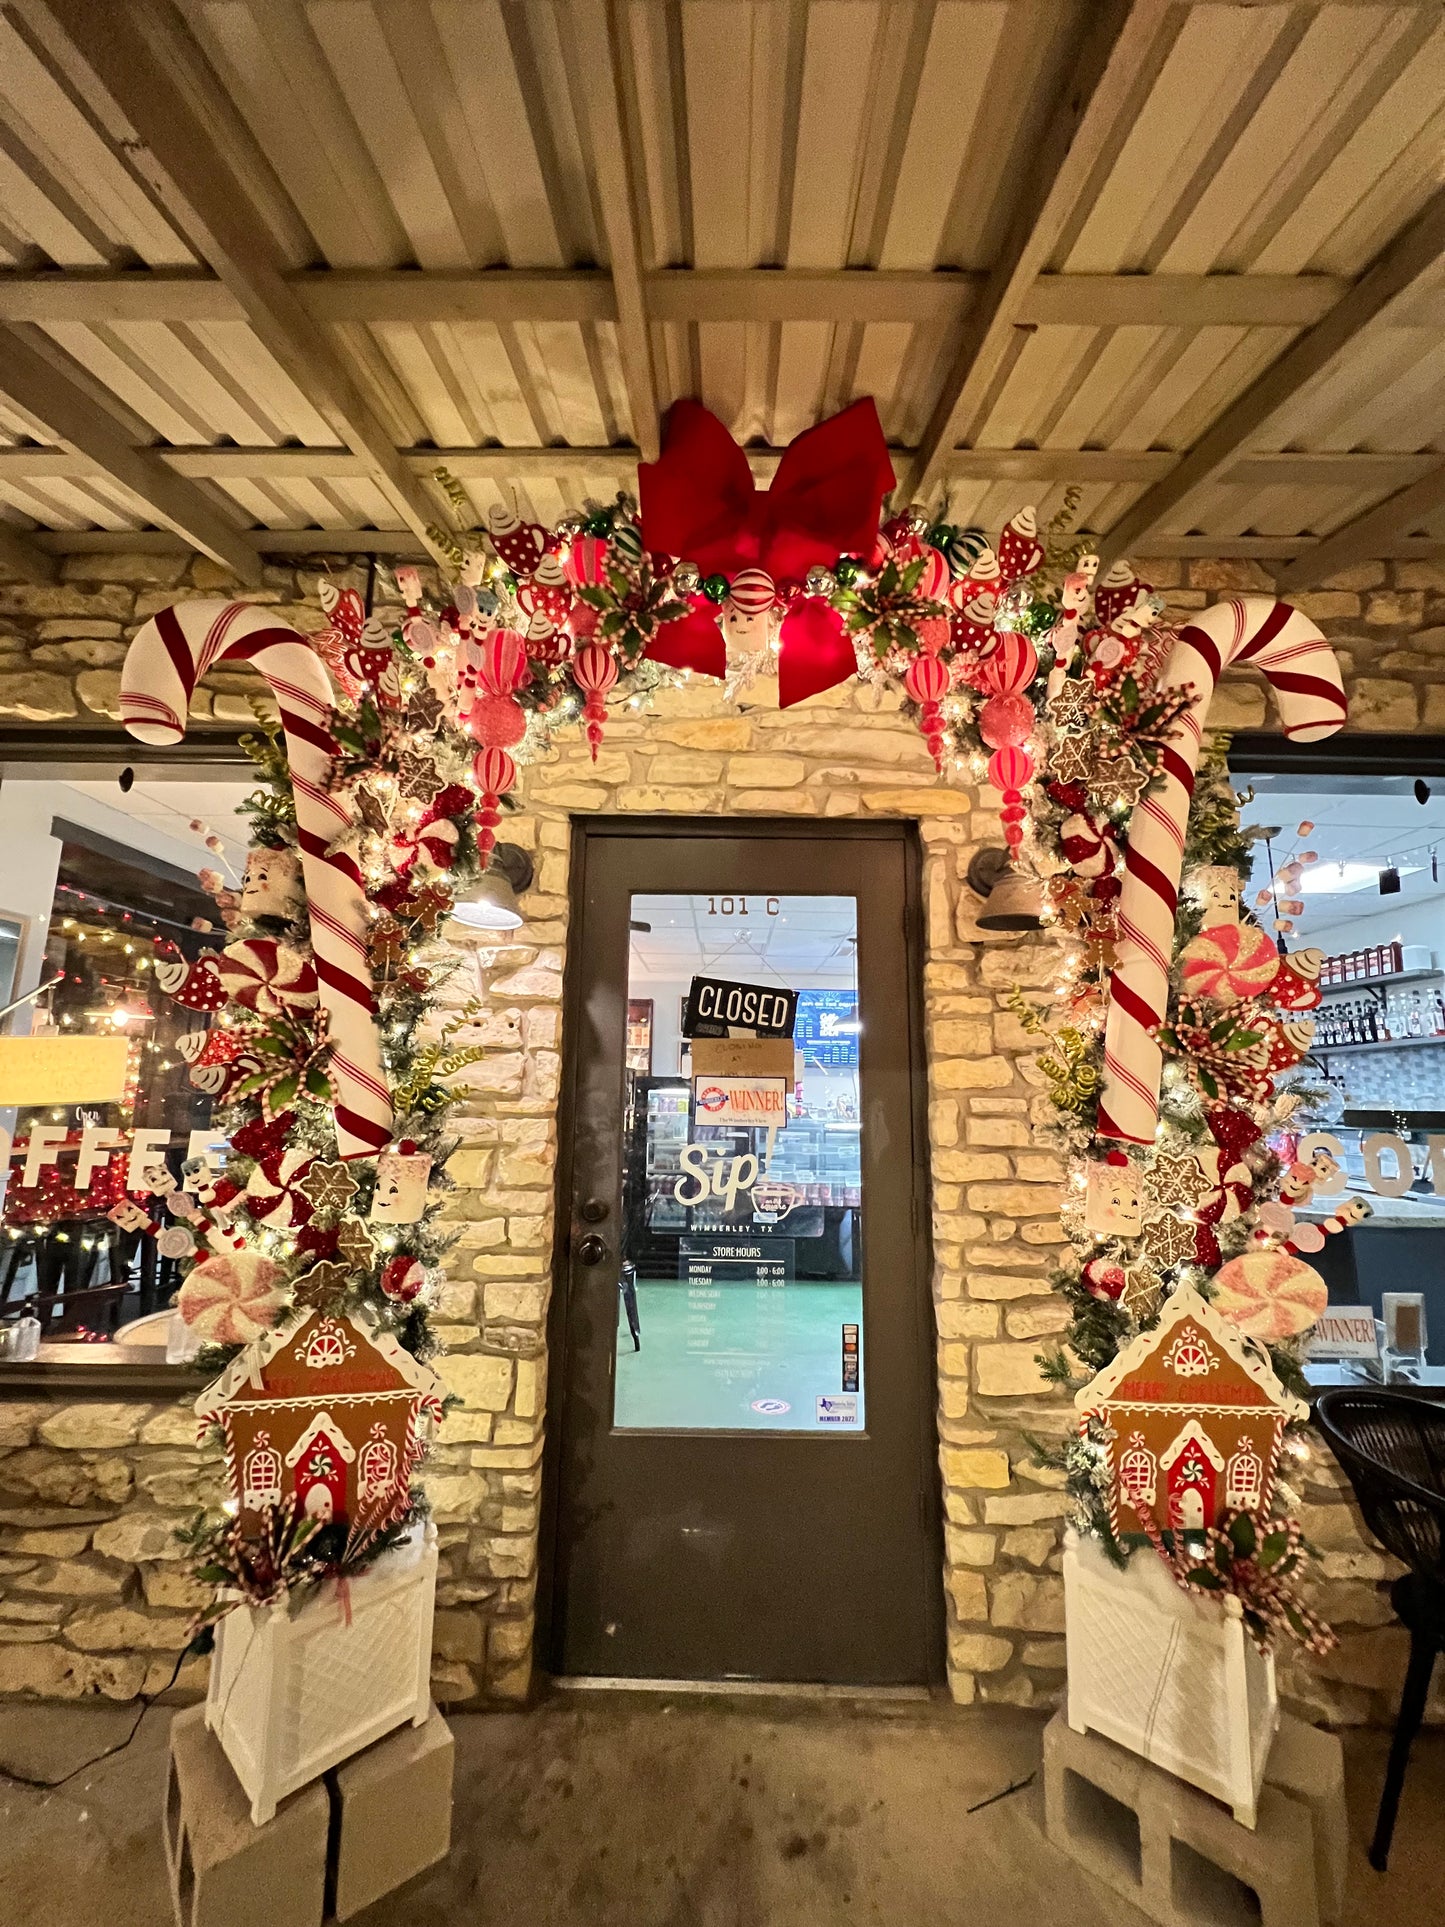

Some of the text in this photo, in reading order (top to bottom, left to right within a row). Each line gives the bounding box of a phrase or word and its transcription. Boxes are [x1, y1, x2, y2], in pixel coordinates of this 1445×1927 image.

[708, 897, 780, 916] 101 C
[698, 985, 789, 1028] CLOSED
[729, 1089, 784, 1112] WINNER!
[75, 1106, 101, 1128] Open
[0, 1125, 228, 1193] FFEE
[674, 1126, 778, 1212] Sip!
[713, 1246, 761, 1258] STORE HOURS
[689, 1265, 712, 1274] MONDAY
[689, 1277, 712, 1286] TUESDAY
